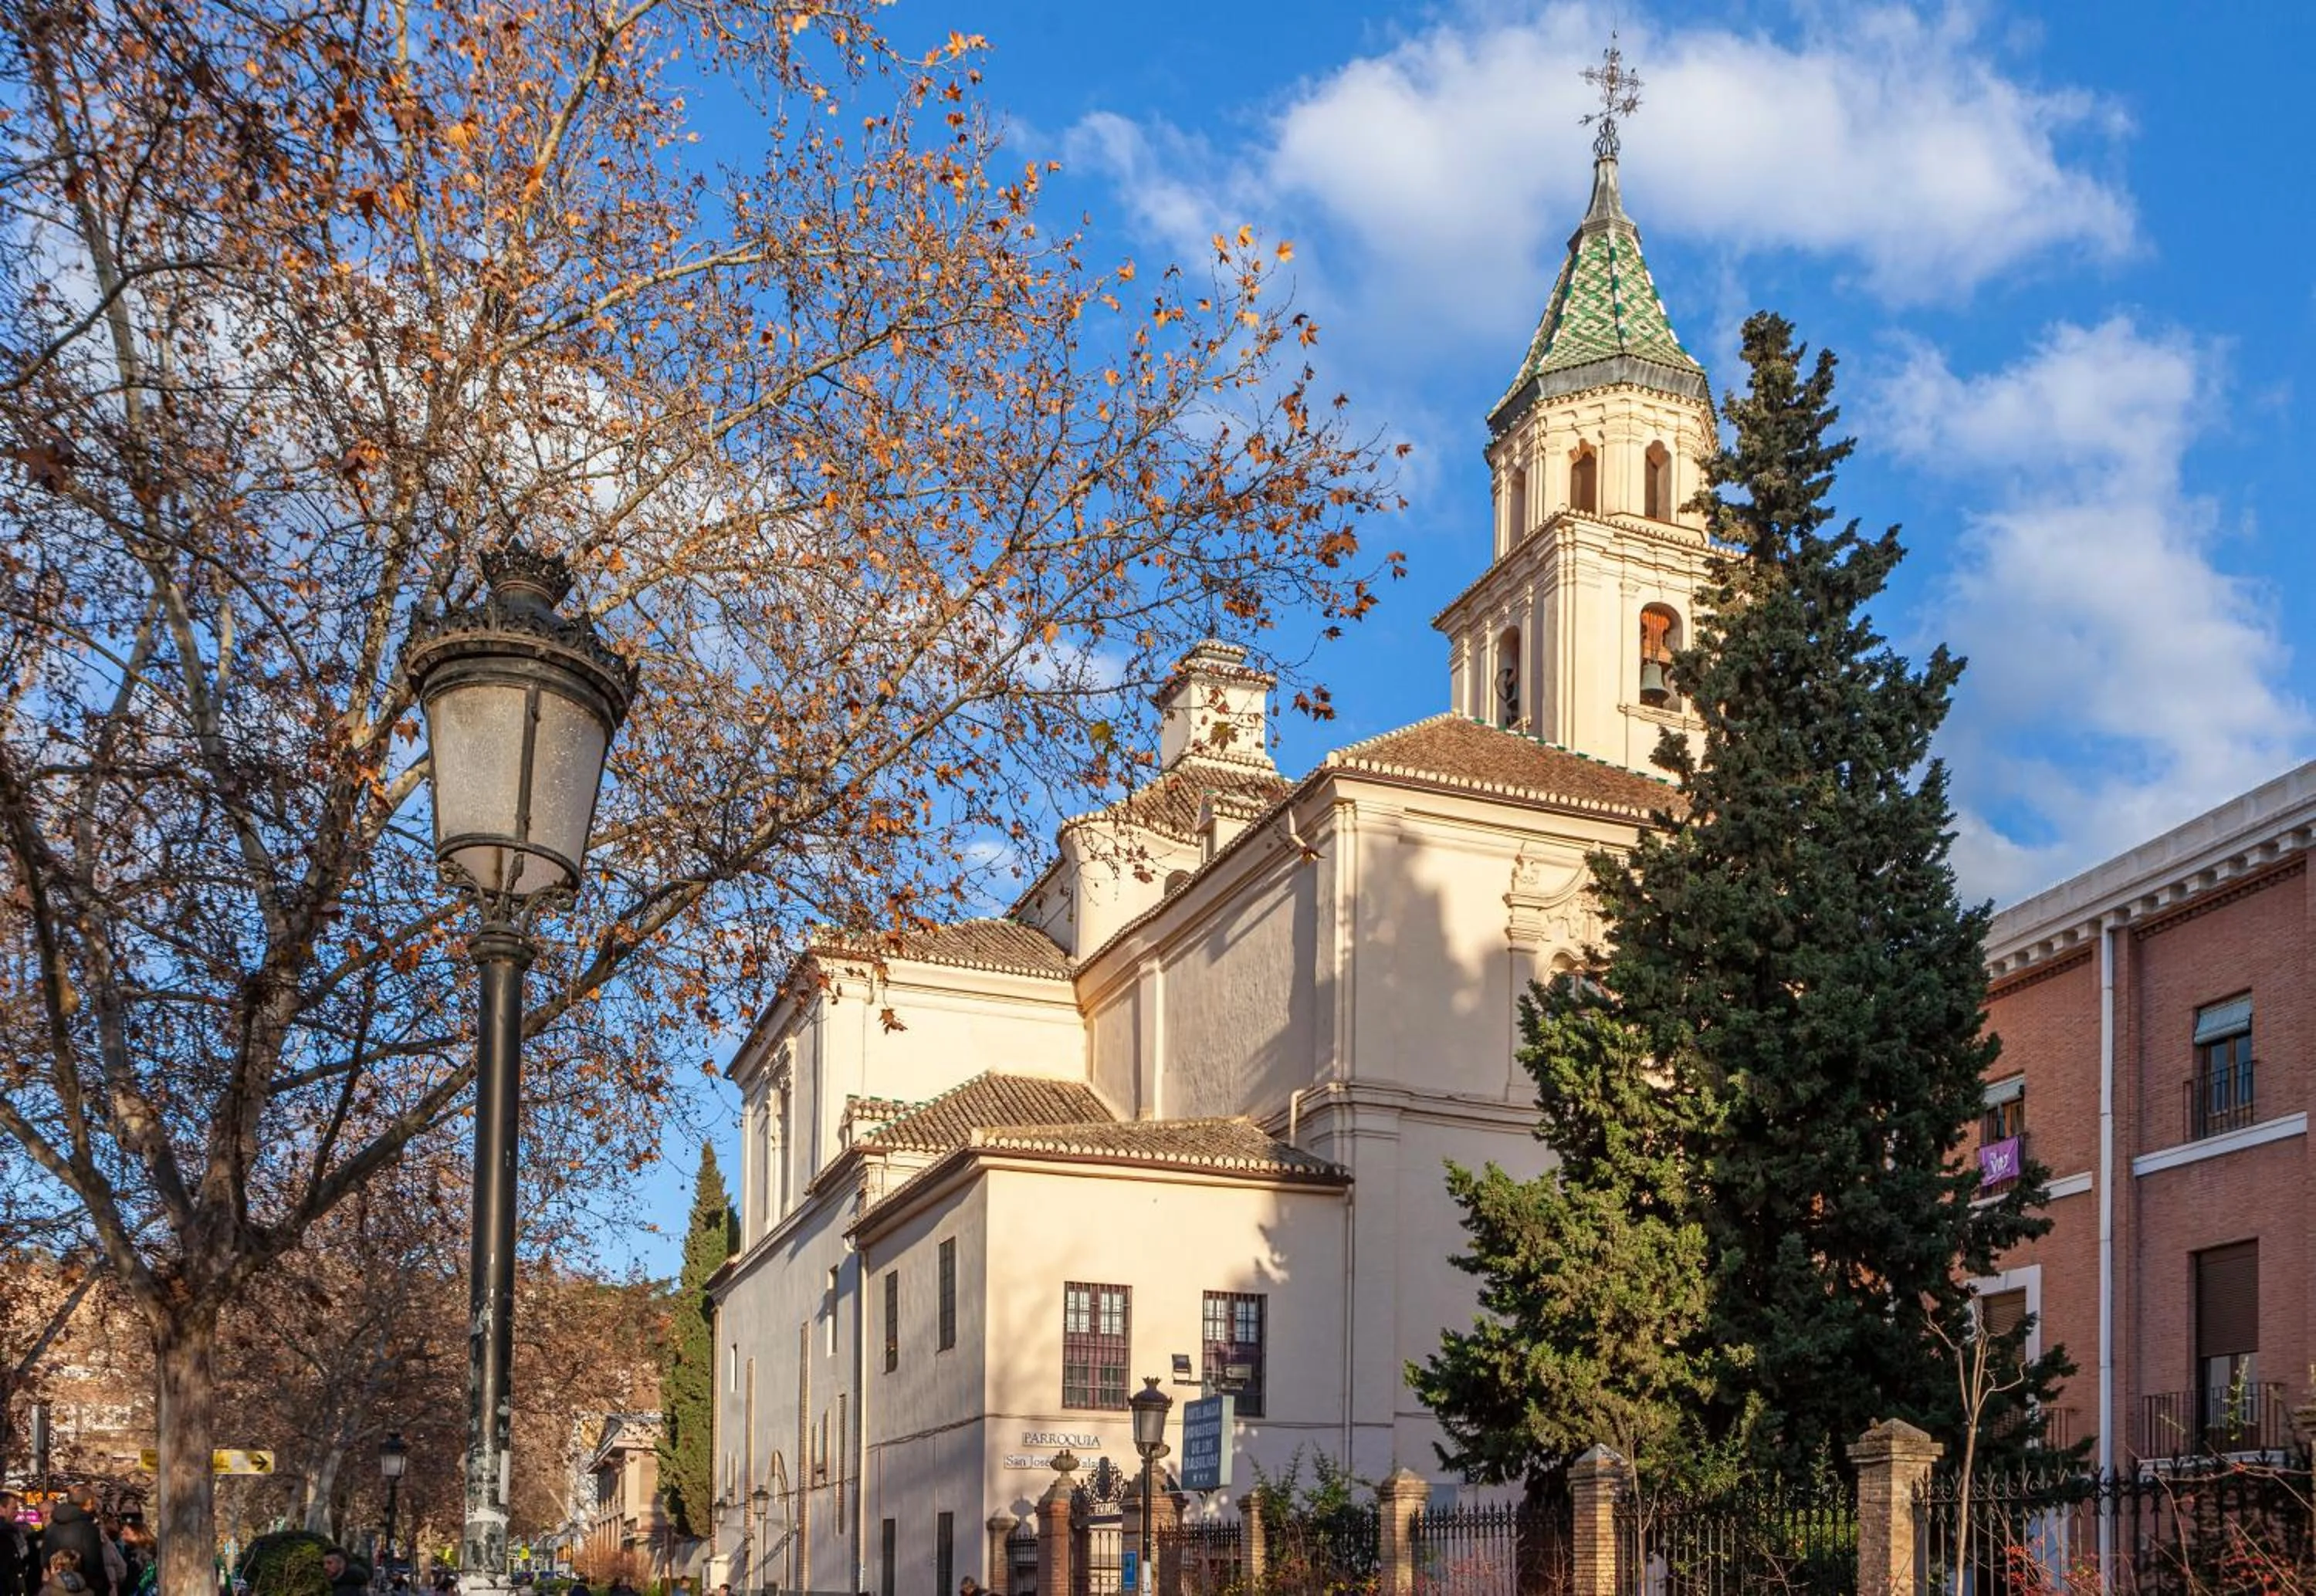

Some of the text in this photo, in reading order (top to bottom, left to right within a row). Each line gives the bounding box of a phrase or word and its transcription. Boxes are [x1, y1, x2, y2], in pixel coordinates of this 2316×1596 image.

[1024, 1432, 1101, 1447] PARROQUIA
[1006, 1455, 1026, 1466] San
[1184, 1452, 1218, 1471] BASILIOS
